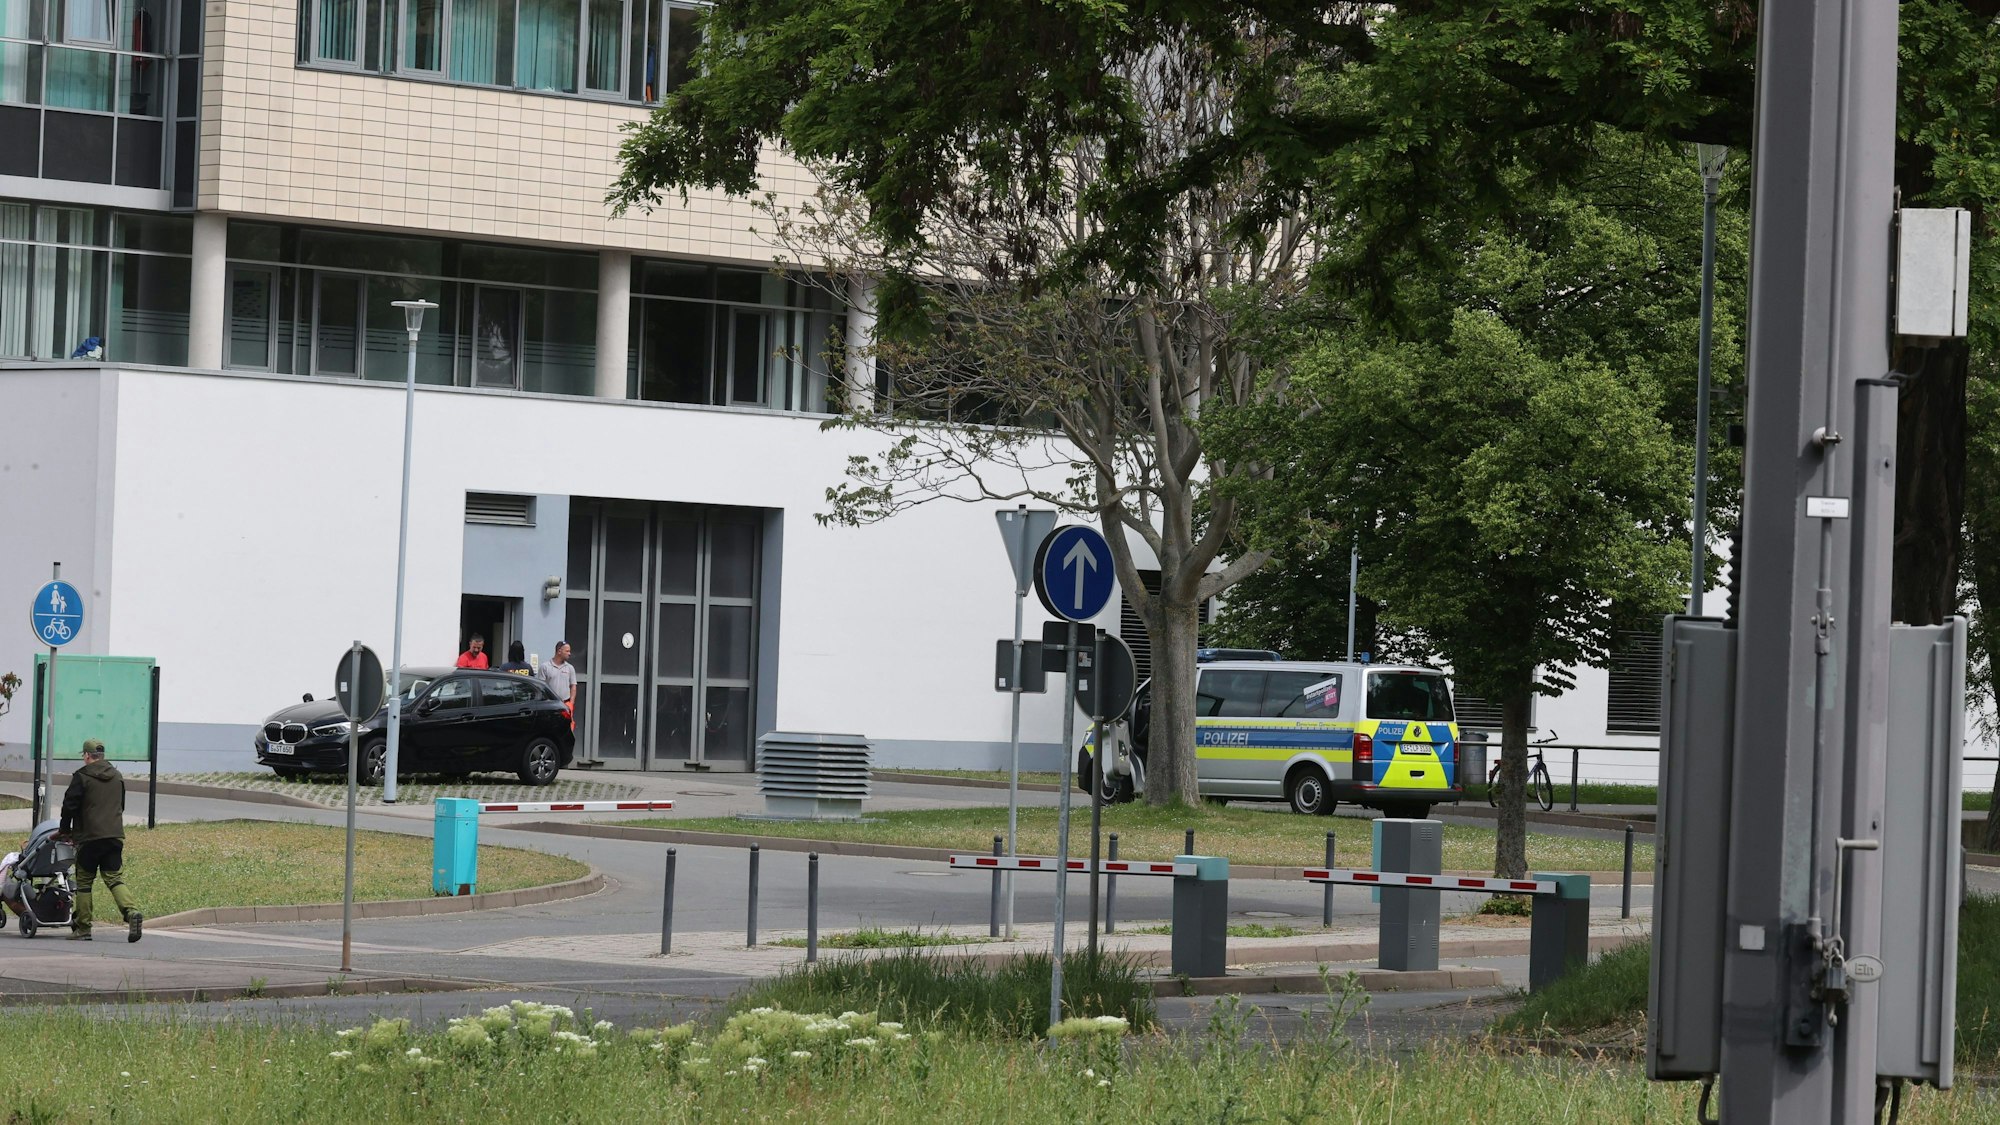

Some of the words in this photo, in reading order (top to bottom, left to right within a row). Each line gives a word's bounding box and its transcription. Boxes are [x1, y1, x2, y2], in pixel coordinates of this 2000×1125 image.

[1203, 731, 1249, 745] POLIZEI
[1378, 727, 1404, 735] POLIZEI
[1855, 962, 1874, 976] Ein
